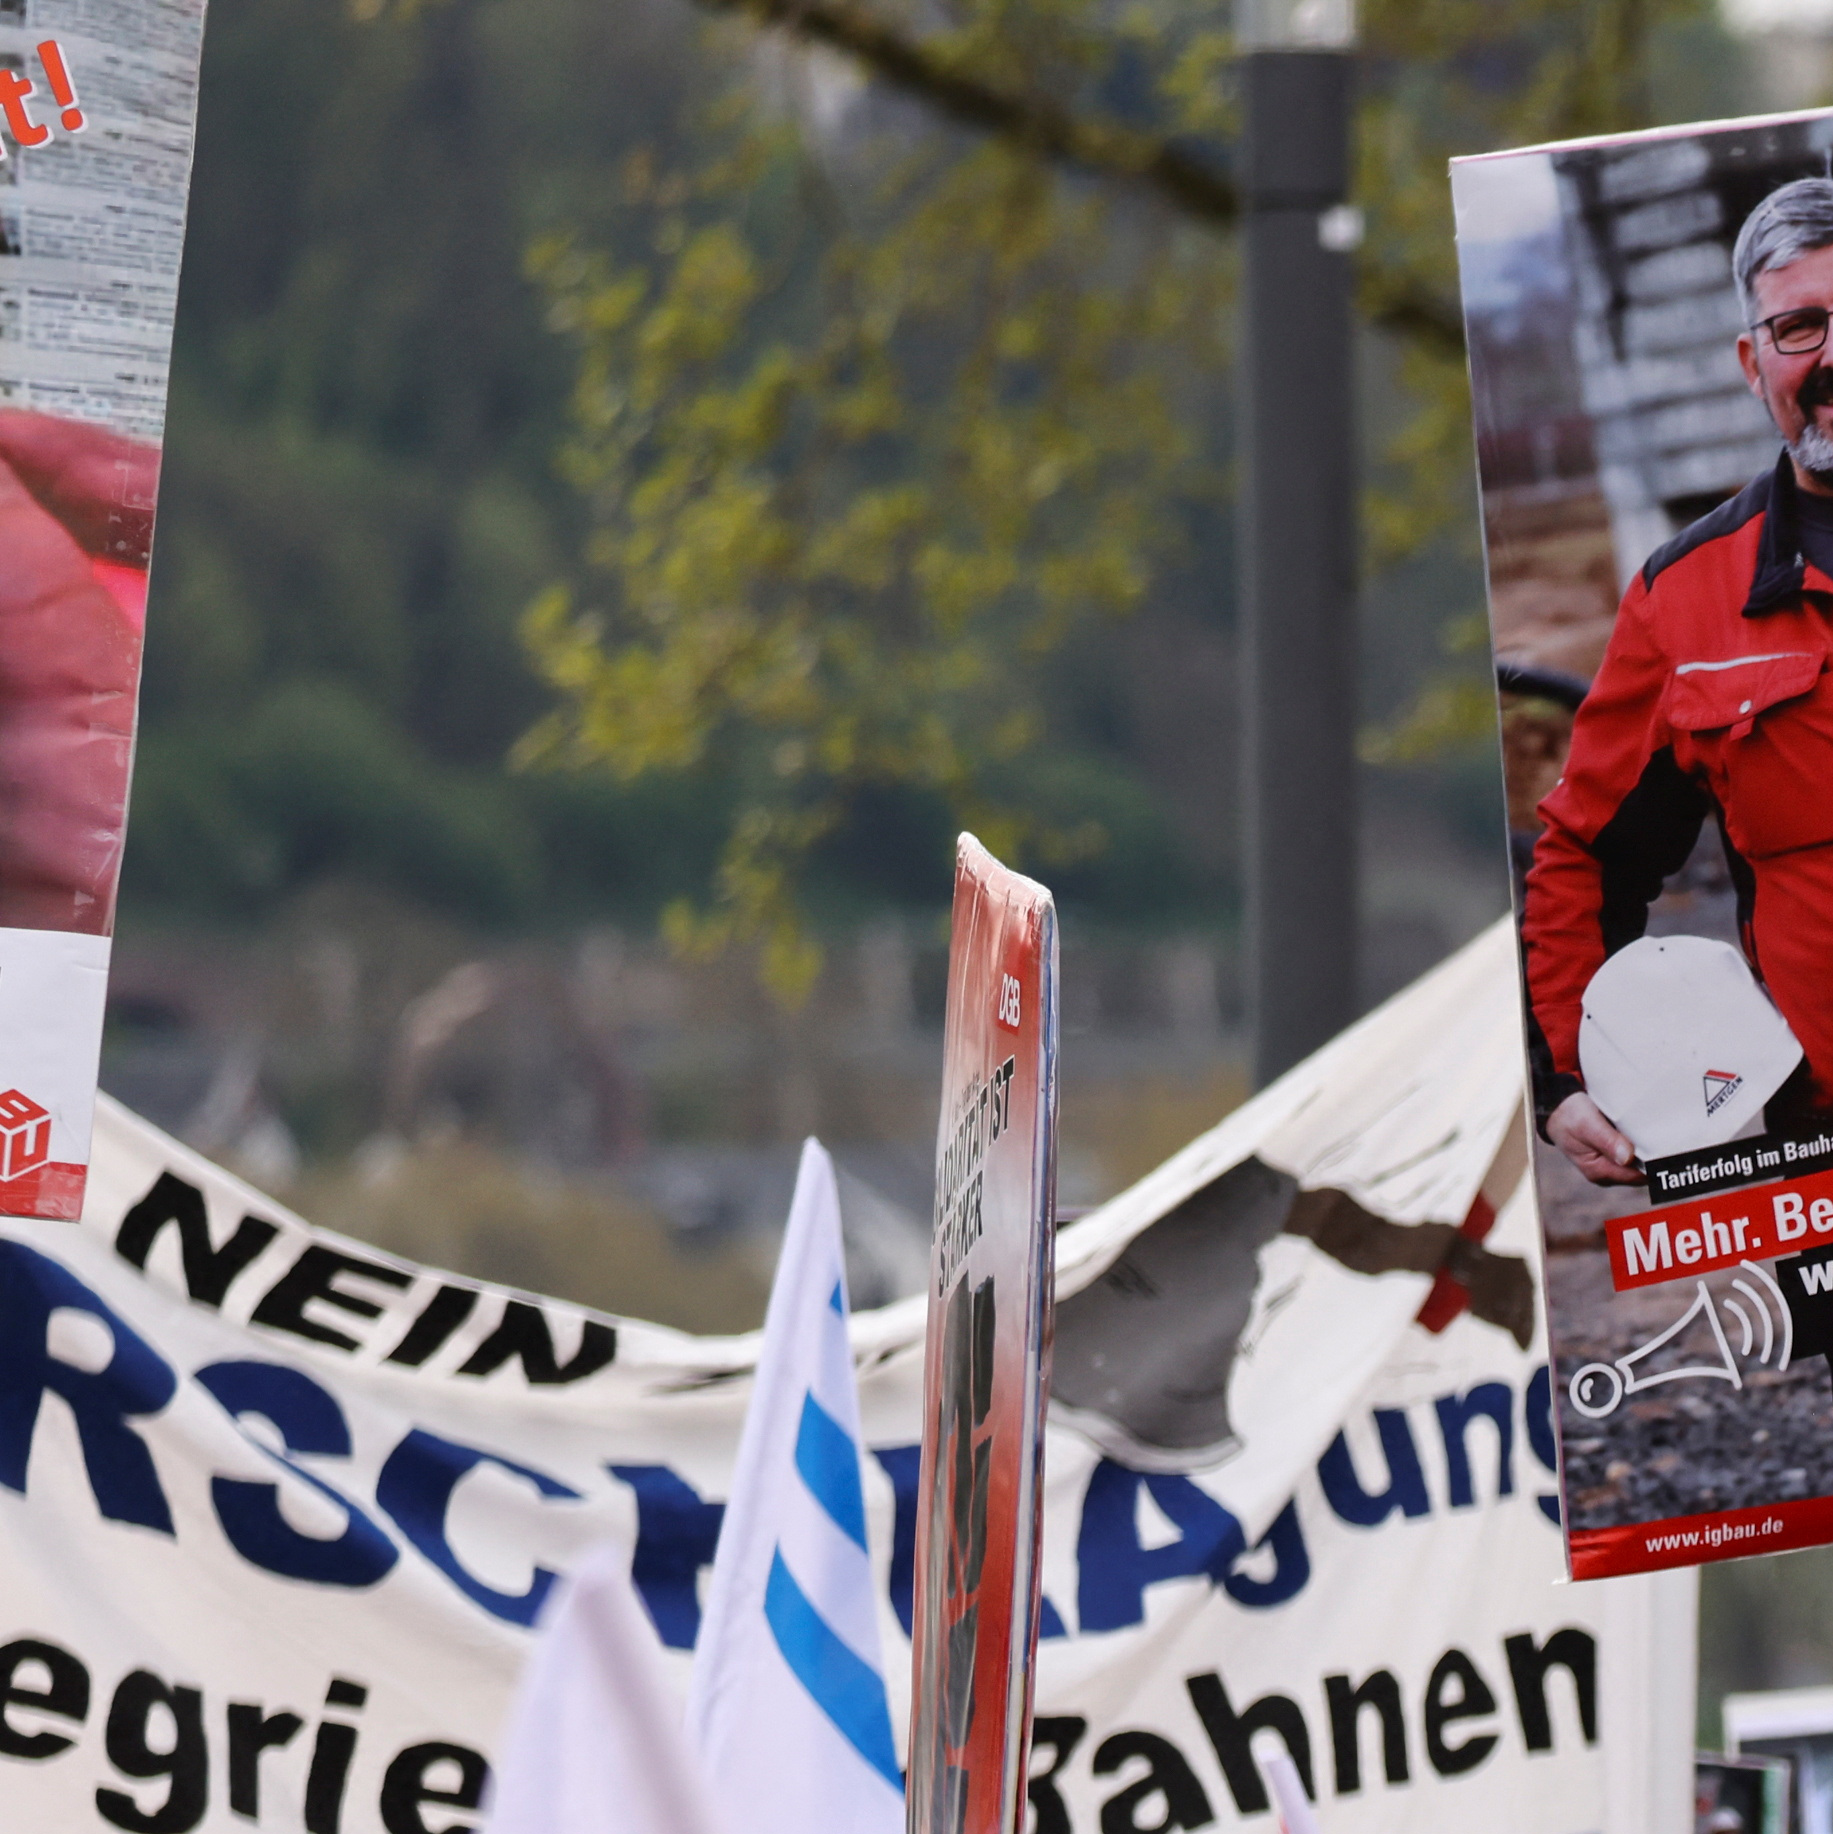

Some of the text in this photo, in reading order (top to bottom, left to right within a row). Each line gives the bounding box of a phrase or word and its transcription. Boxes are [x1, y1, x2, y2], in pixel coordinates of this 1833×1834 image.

[999, 973, 1020, 1027] DGB
[988, 1055, 1015, 1147] IST
[1706, 1075, 1743, 1117] MERTGEN
[1657, 1153, 1753, 1192] Tariferfolg
[1756, 1147, 1780, 1169] im
[1623, 1212, 1762, 1276] Mehr.
[115, 1170, 617, 1385] NEIN
[1646, 1517, 1783, 1553] www.igbau.de
